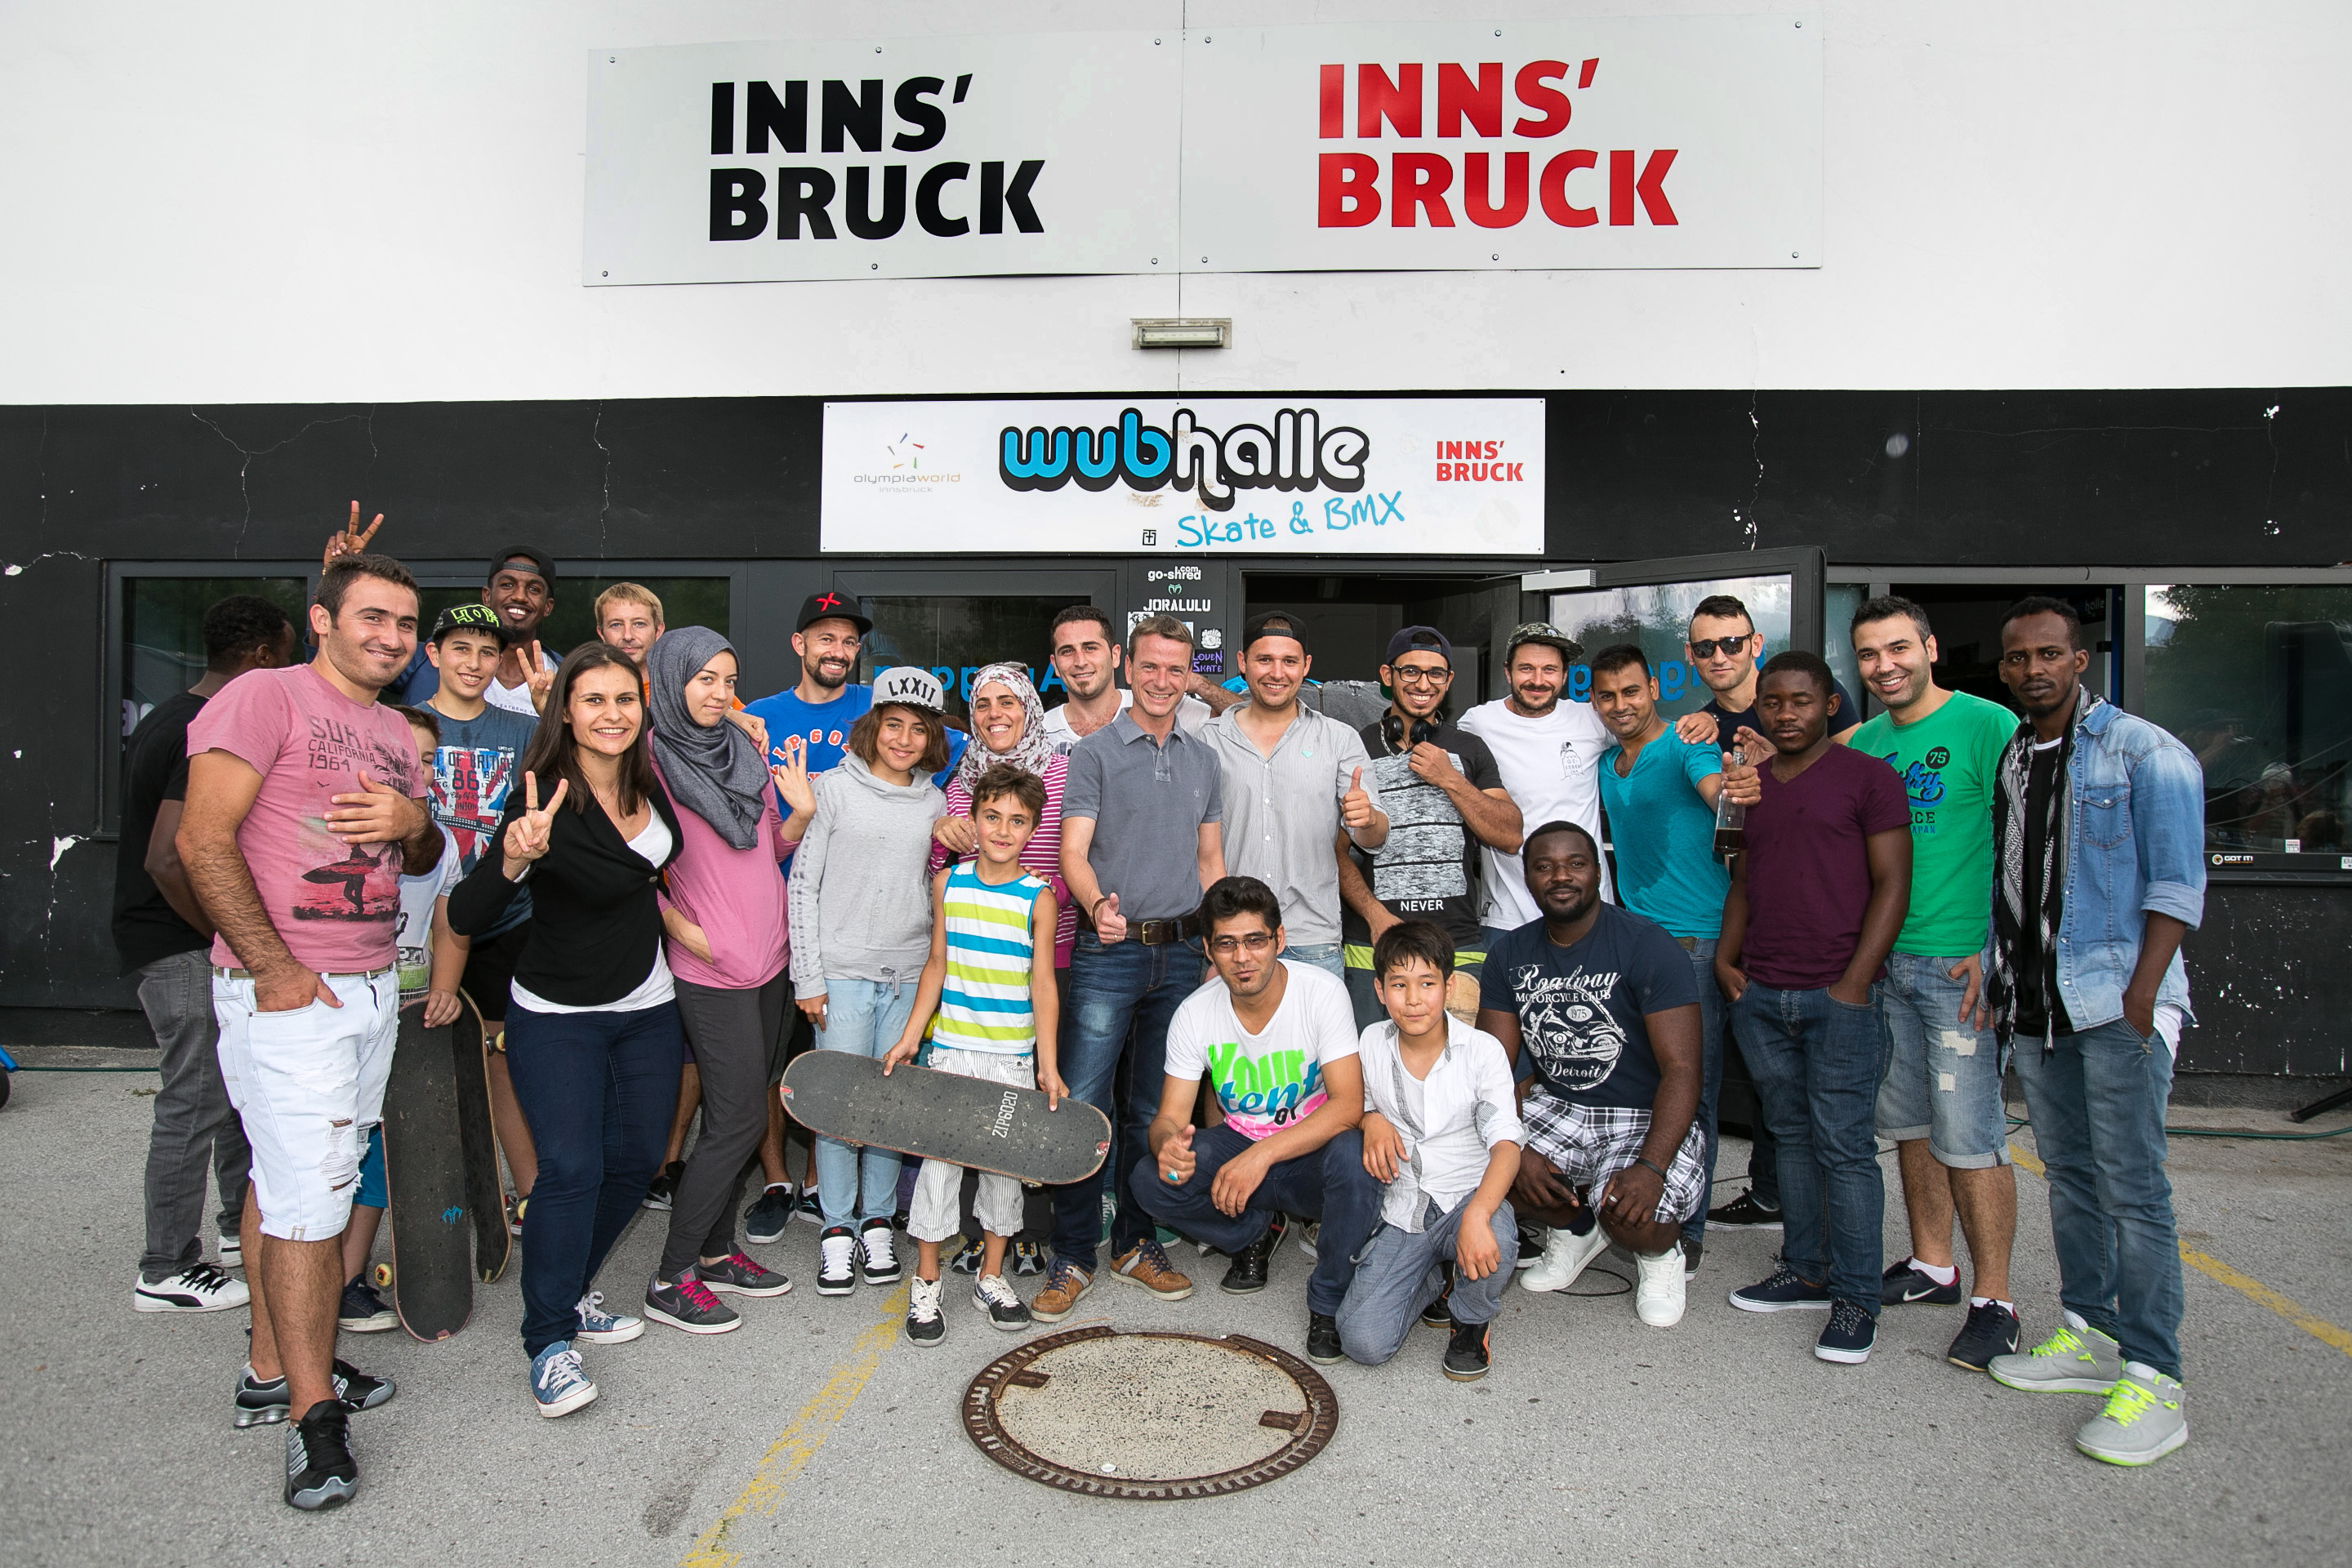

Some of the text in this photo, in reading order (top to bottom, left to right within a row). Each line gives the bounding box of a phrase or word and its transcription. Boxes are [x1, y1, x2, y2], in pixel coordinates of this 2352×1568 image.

[1319, 58, 1599, 139] INNS'
[710, 74, 973, 154] INNS'
[1318, 149, 1678, 228] BRUCK
[709, 160, 1045, 241] BRUCK
[1000, 408, 1370, 512] wubhalle
[1437, 440, 1504, 460] INNS'
[853, 474, 960, 484] olympiaworld
[1436, 463, 1523, 482] BRUCK
[1178, 491, 1405, 547] Skate & BMX
[1143, 599, 1211, 612] JORALULU
[889, 677, 936, 702] LXXII
[500, 703, 528, 713] EXTREME
[308, 738, 376, 764] CALIFORNIA
[1930, 751, 1948, 764] 75
[308, 753, 350, 772] 1964
[448, 752, 463, 766] OF
[470, 753, 514, 773] BRITISH
[452, 769, 480, 791] 86
[1912, 826, 1936, 834] APAN
[1401, 900, 1444, 911] NEVER
[1509, 964, 1622, 996] Roadway
[1516, 989, 1610, 1004] MOTORCYCLE CLUB
[1570, 1008, 1588, 1019] 1975
[1208, 1043, 1305, 1102] Your
[1545, 1058, 1603, 1078] Detroit
[991, 1090, 1018, 1138] ZIP6020
